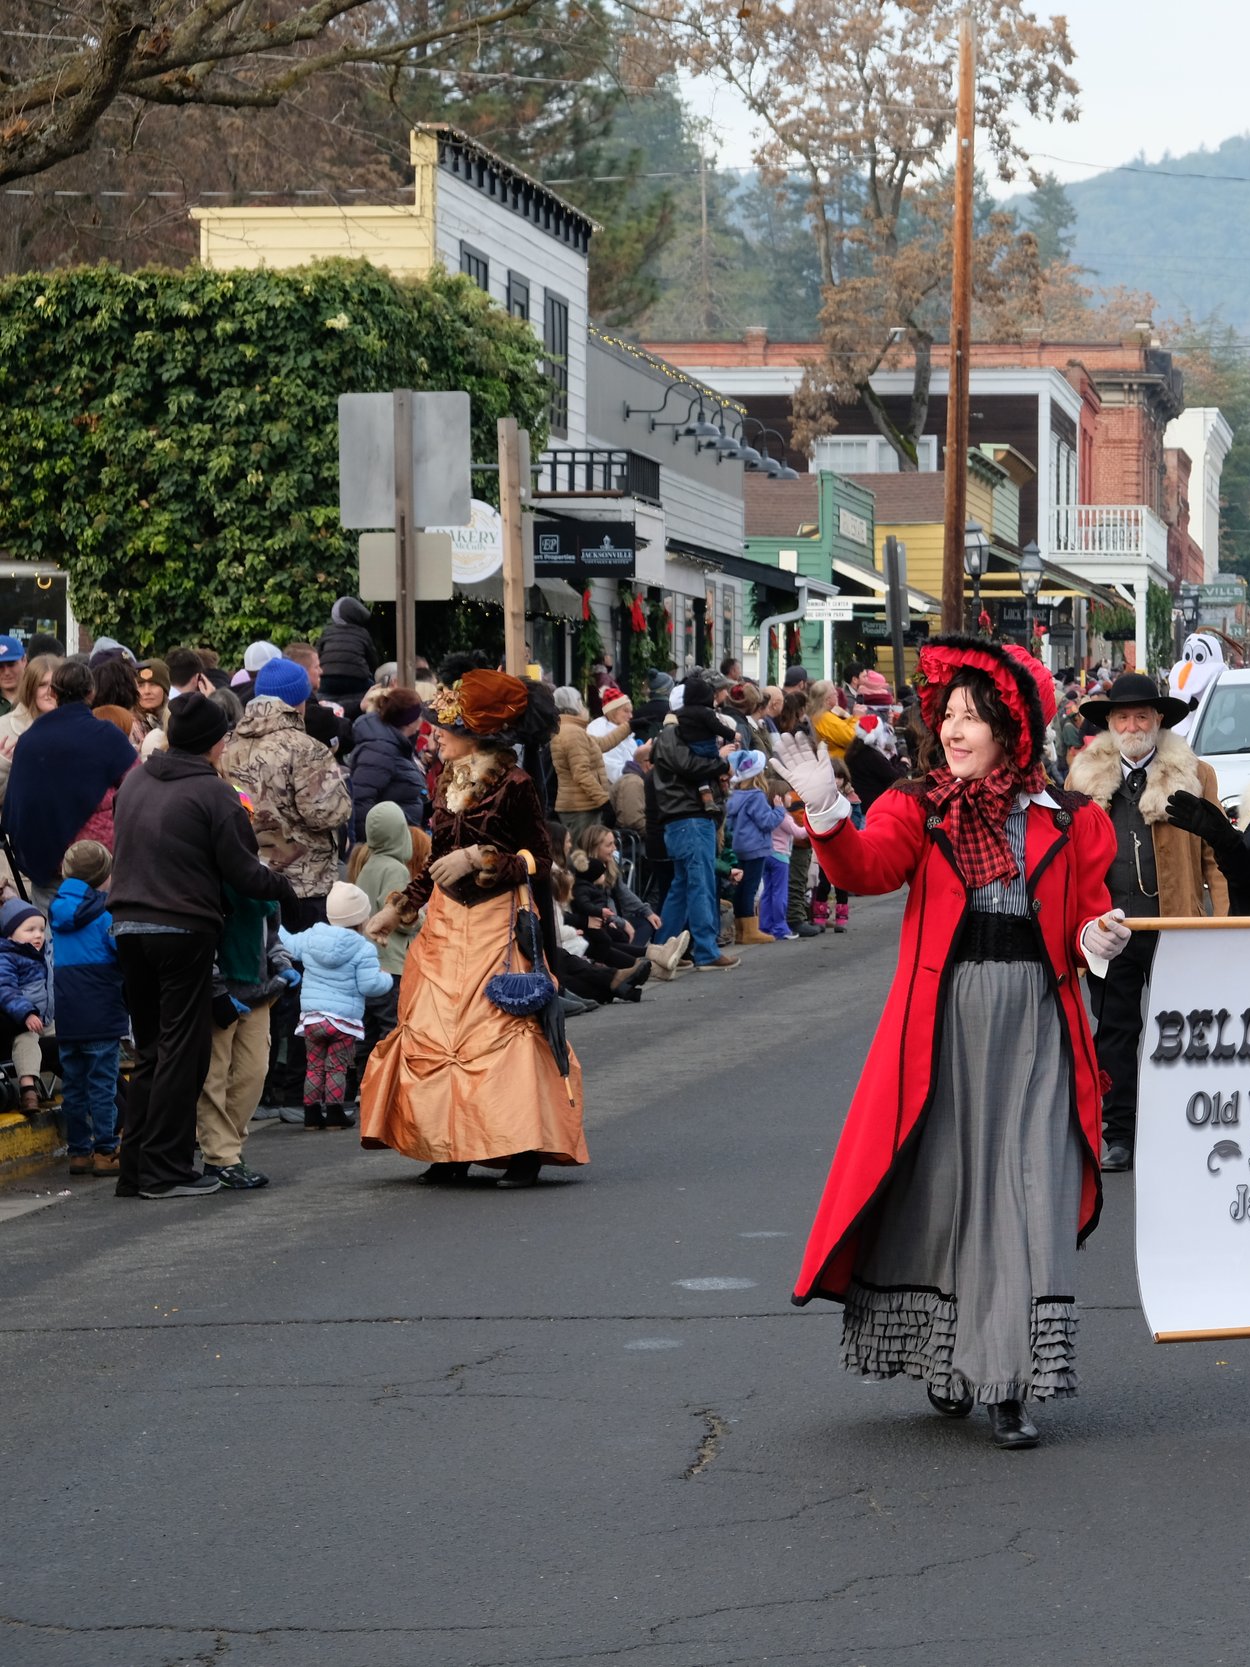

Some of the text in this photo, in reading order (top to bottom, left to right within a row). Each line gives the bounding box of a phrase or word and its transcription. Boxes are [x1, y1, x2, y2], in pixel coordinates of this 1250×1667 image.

[581, 550, 633, 559] JACKSONVILLE
[1204, 587, 1243, 596] VILLE
[1003, 607, 1047, 621] LOCK HSE
[1186, 1090, 1240, 1126] Old
